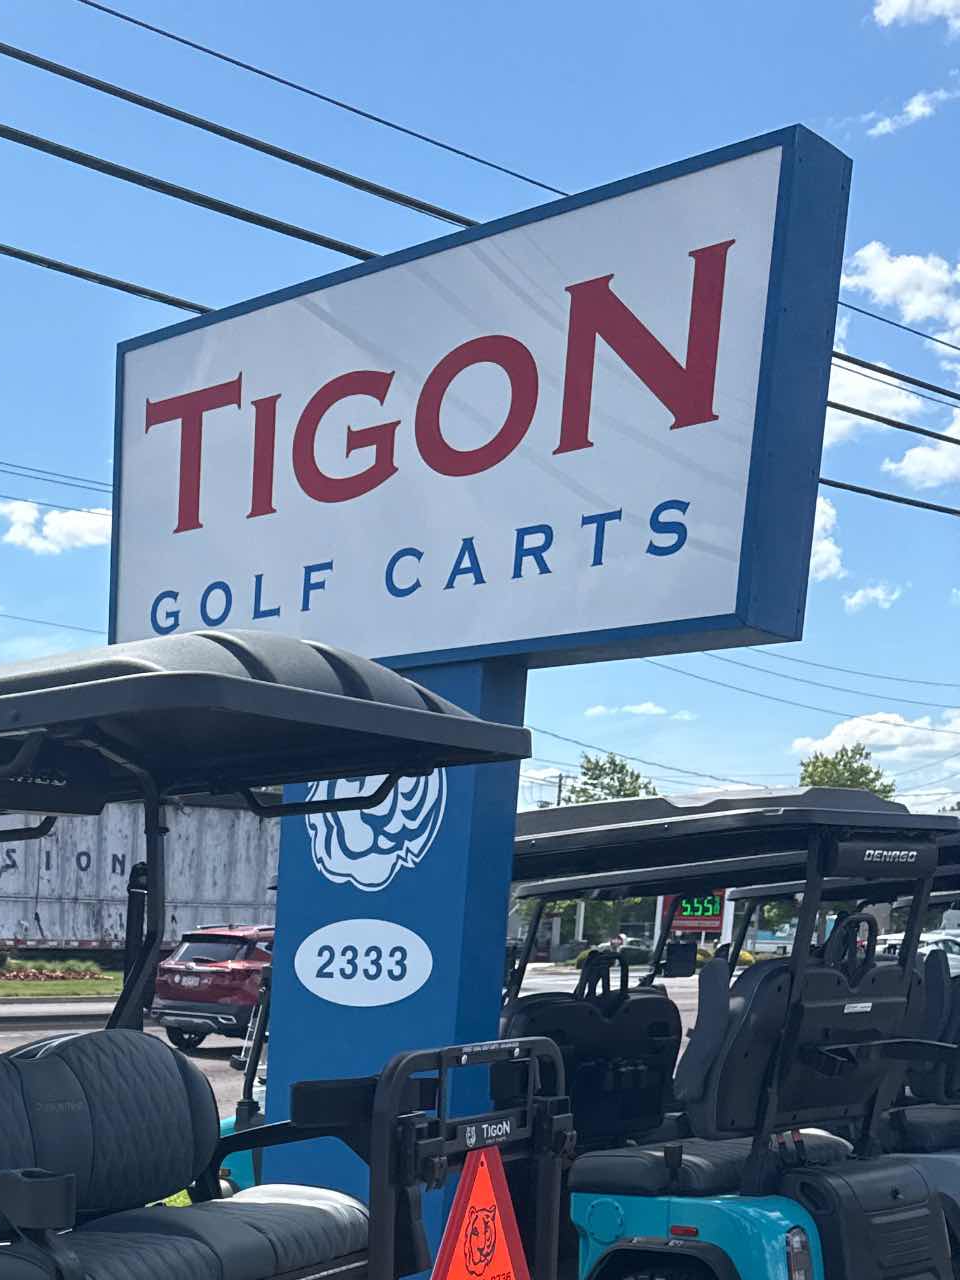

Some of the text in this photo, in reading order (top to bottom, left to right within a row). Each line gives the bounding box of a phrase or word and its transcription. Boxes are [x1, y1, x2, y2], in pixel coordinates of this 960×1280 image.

[145, 238, 737, 534] TIGON
[150, 499, 691, 635] GOLF CARTS
[863, 849, 918, 862] DENAGO
[315, 944, 408, 982] 2333
[481, 1119, 511, 1138] TIGON
